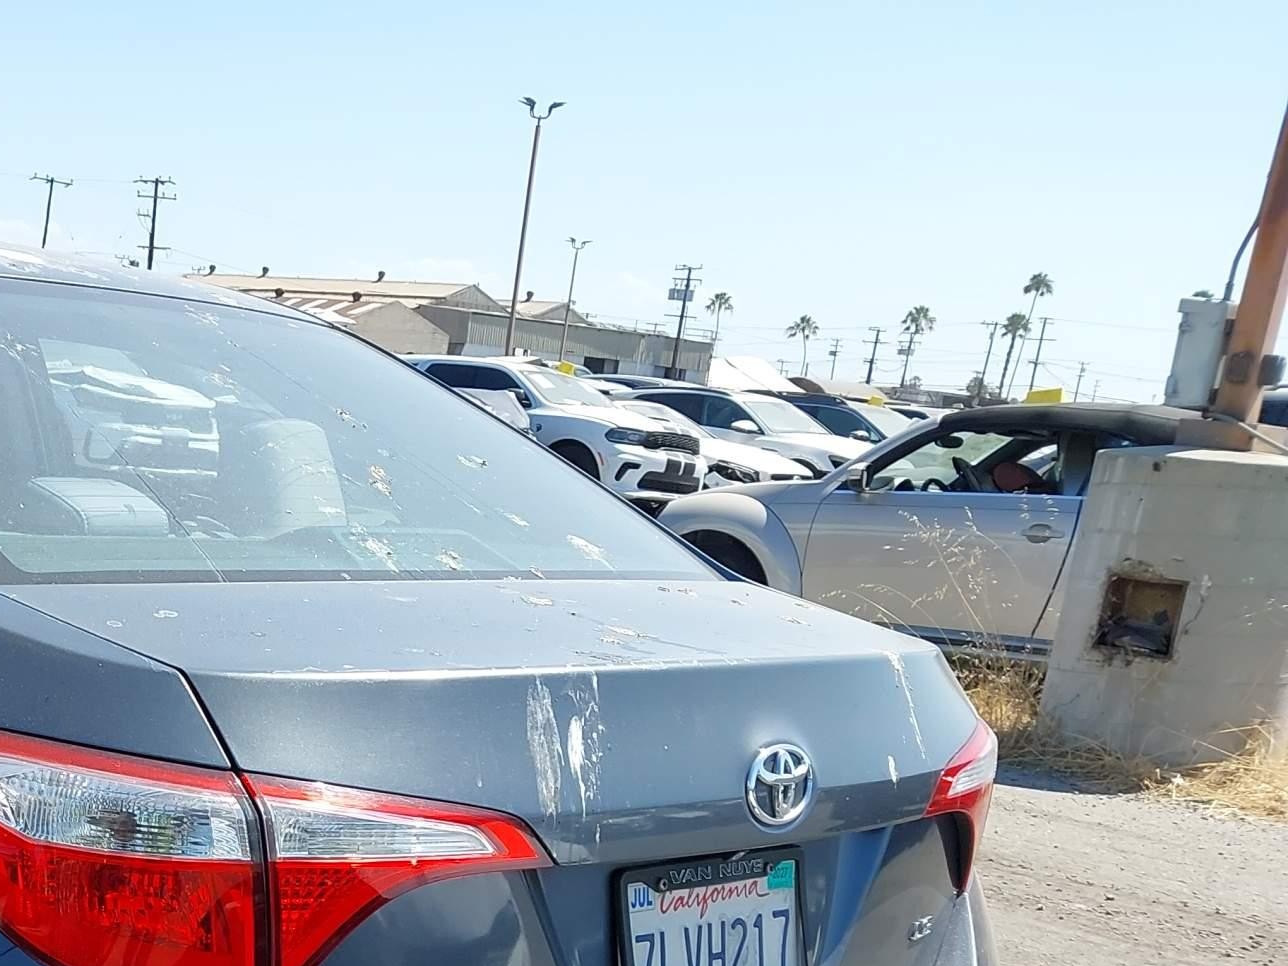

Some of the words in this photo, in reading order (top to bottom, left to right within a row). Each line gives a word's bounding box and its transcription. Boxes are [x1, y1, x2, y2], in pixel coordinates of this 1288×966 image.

[669, 866, 712, 884] VAN
[719, 859, 764, 878] NUYS
[631, 886, 654, 909] JUL
[659, 880, 770, 919] California
